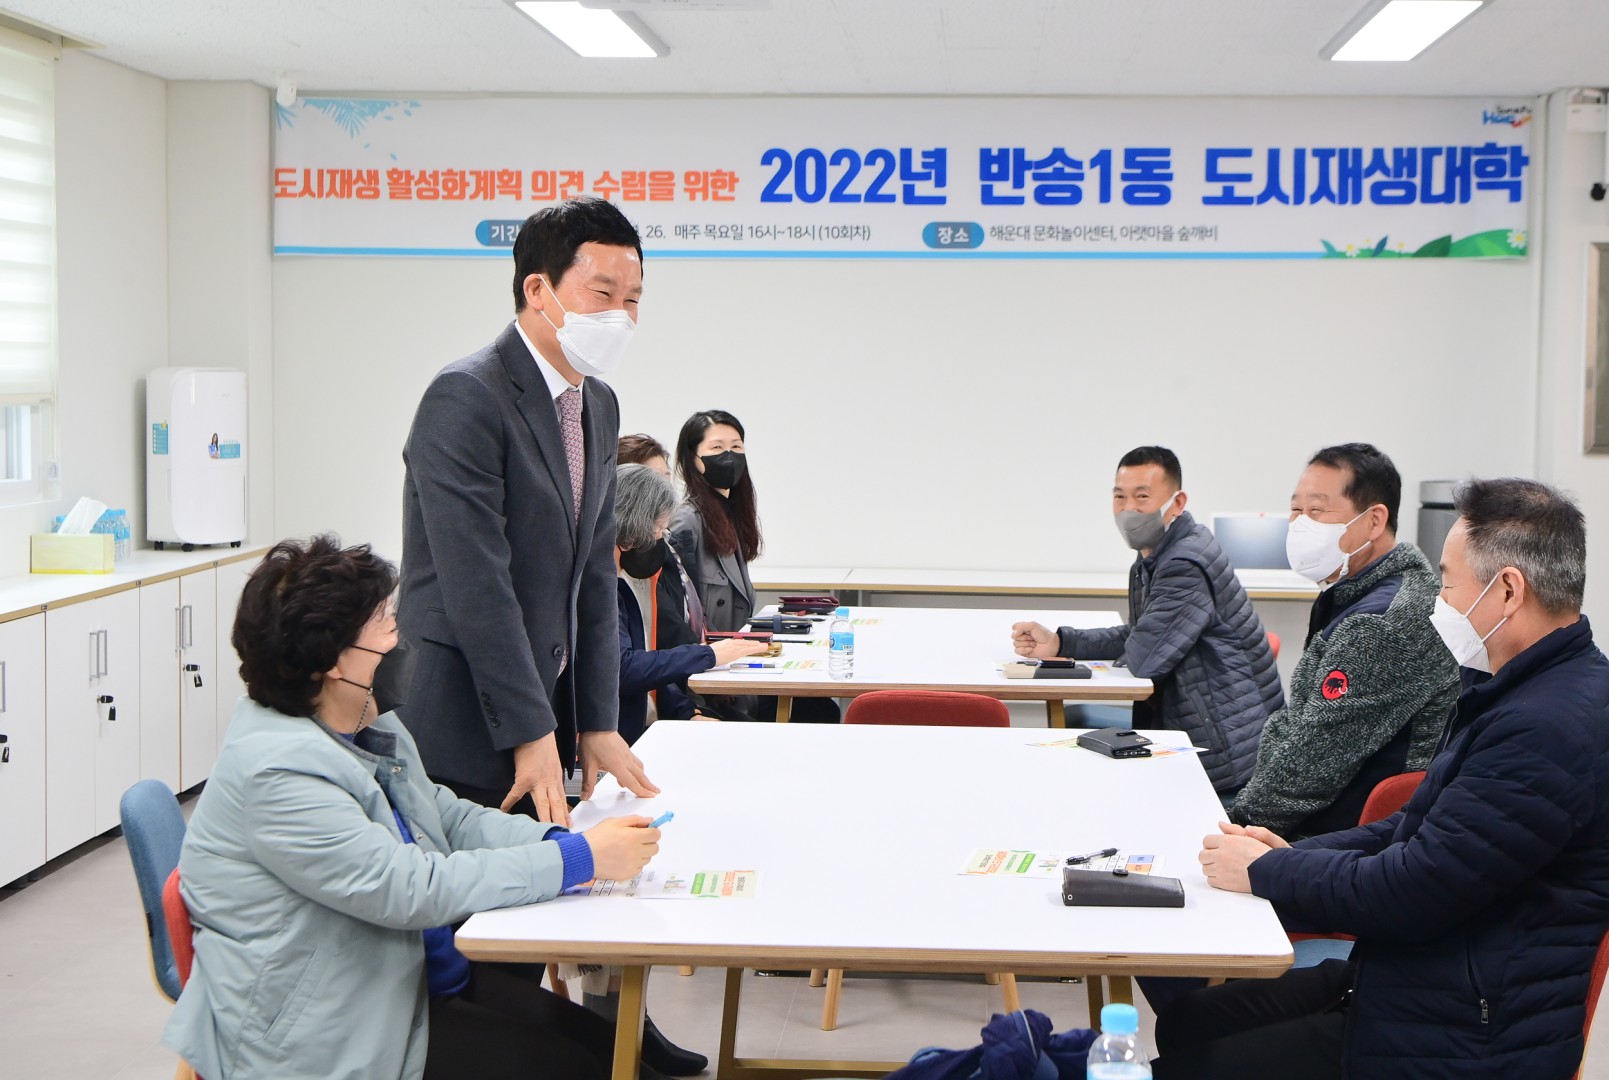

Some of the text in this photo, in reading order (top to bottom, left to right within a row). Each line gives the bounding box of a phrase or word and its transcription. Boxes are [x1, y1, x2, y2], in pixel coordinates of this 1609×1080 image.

[760, 142, 1530, 207] 2022년 반송1동 도시재생대학
[274, 167, 740, 202] 도시재생 활성화계획 의견 수렴을 위한
[674, 223, 702, 240] 매주
[704, 223, 744, 241] 목요일
[747, 224, 816, 241] 16시~18시
[818, 224, 871, 242] (10회차)
[938, 226, 970, 245] 장소
[989, 225, 1031, 241] 해운대
[1033, 225, 1117, 242] 문화놀이센터,
[1120, 225, 1174, 242] 아랫마을
